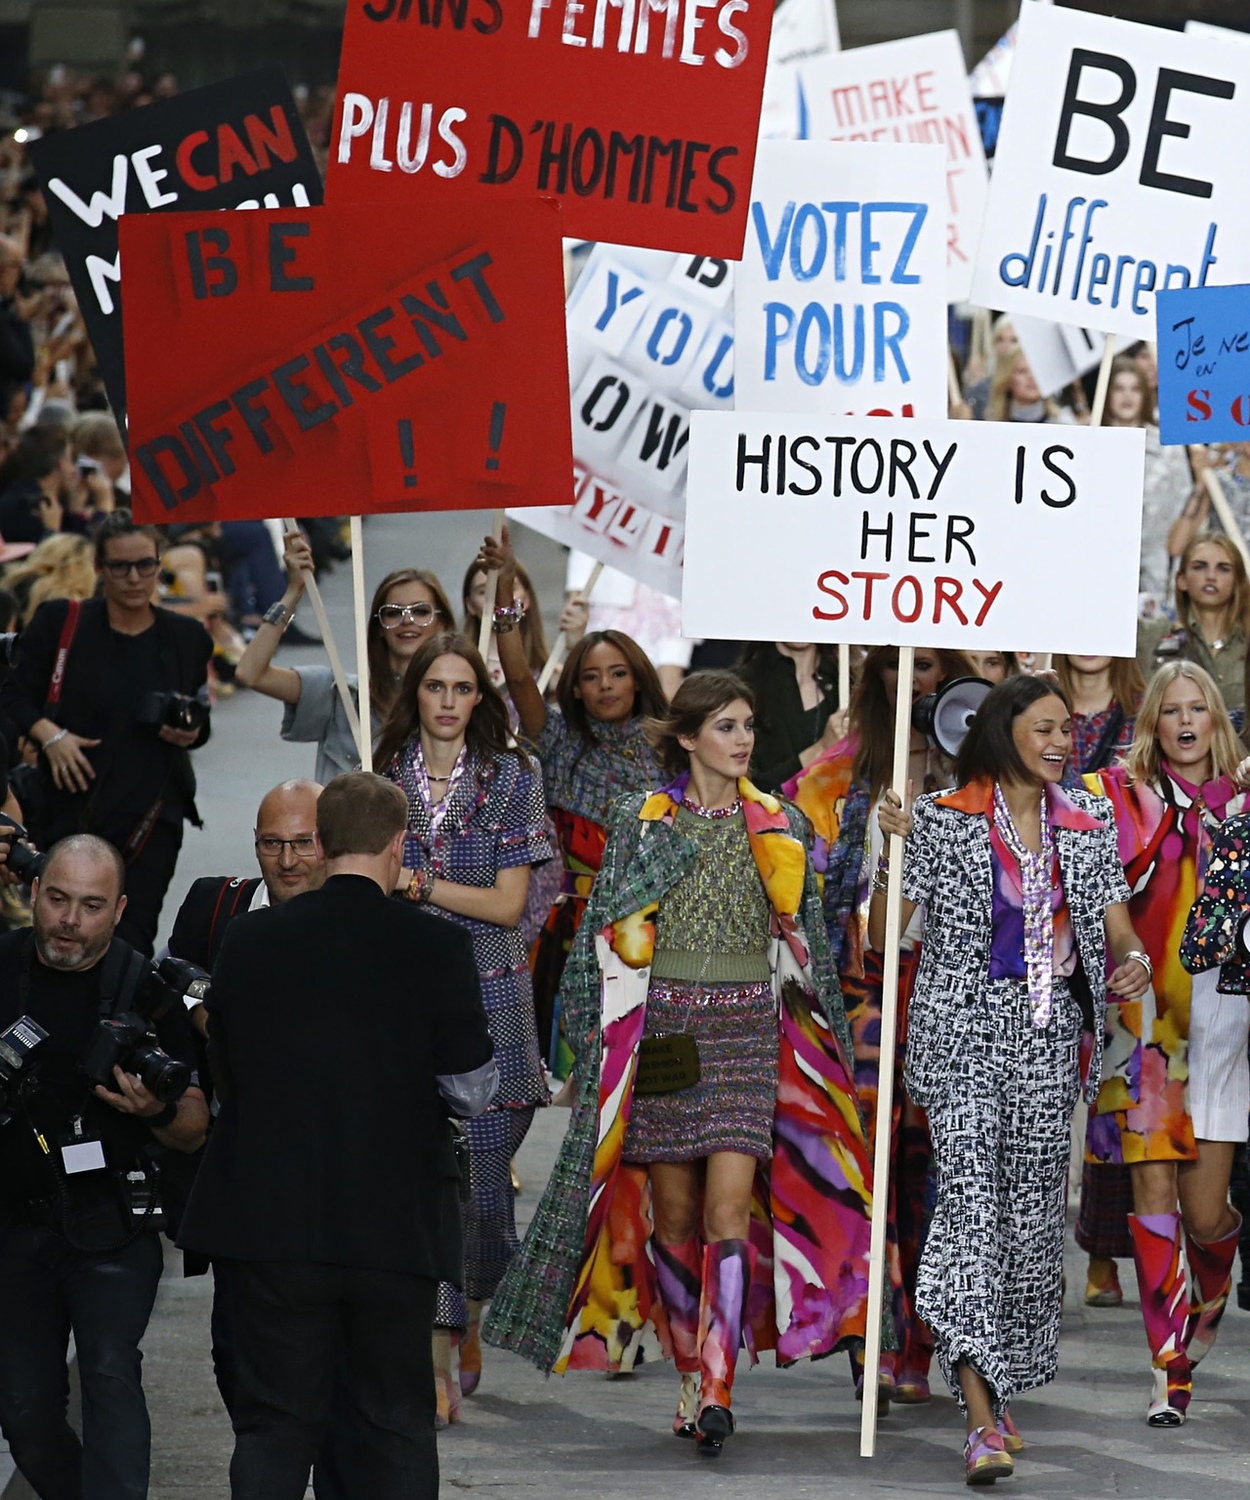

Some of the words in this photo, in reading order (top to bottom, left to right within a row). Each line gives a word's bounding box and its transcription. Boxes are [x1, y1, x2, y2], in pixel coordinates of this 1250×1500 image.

[831, 70, 940, 127] MAKE
[1052, 48, 1235, 199] BE
[48, 144, 178, 228] WE
[175, 105, 299, 192] CAN
[338, 92, 468, 178] PLUS
[478, 114, 740, 215] D'HOMMES
[184, 221, 315, 300] BE
[751, 200, 929, 285] VOTEZ
[135, 252, 506, 511] DIFFERENT
[763, 301, 911, 387] POUR
[1172, 316, 1206, 370] Je
[736, 432, 958, 501] HISTORY
[1013, 444, 1077, 509] IS
[860, 510, 977, 567] HER
[812, 569, 1004, 628] STORY
